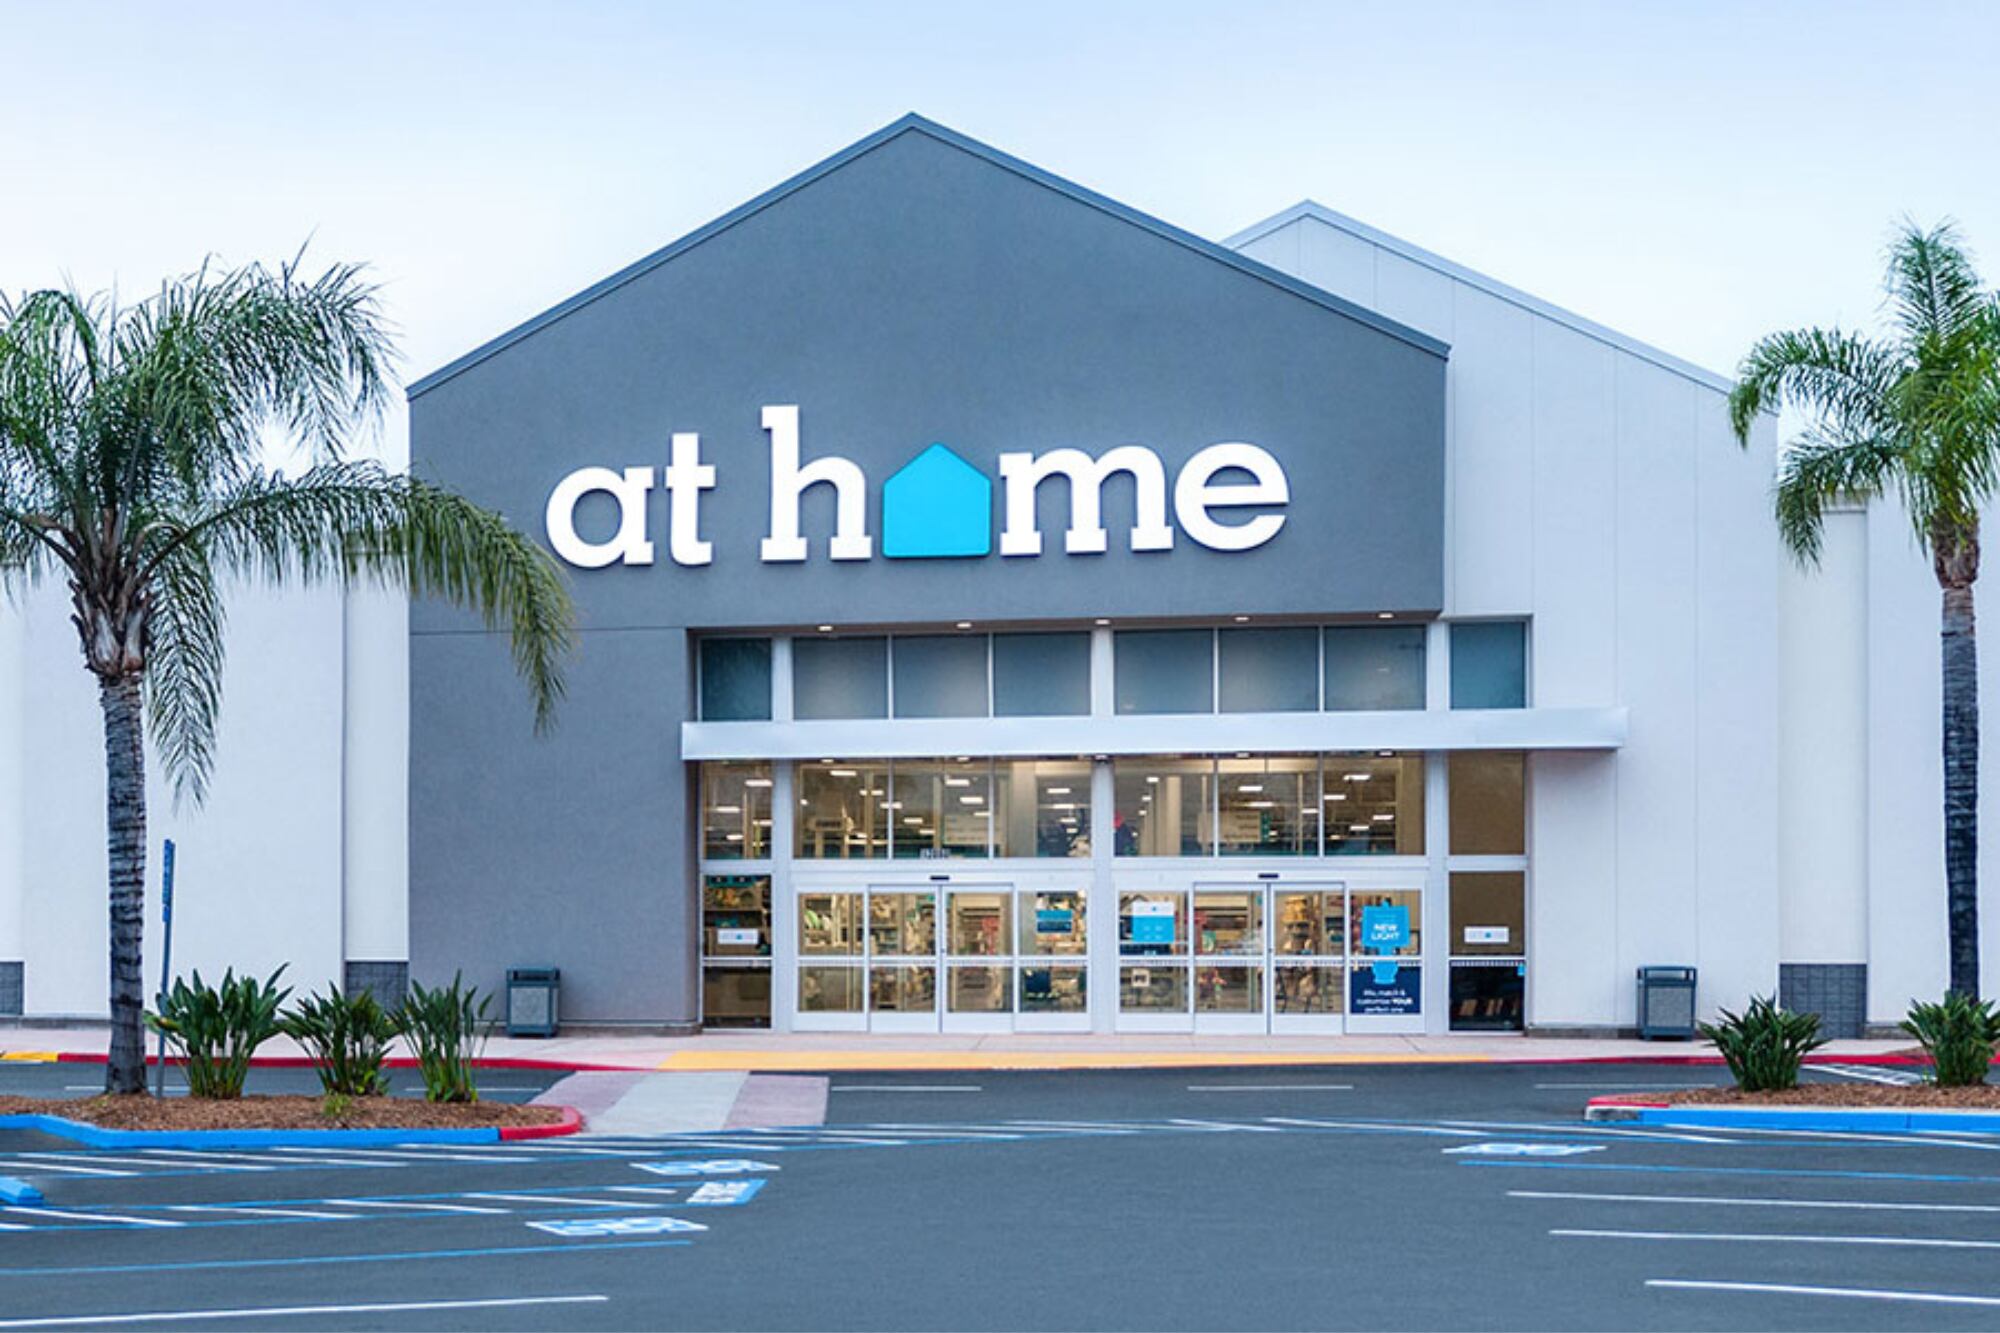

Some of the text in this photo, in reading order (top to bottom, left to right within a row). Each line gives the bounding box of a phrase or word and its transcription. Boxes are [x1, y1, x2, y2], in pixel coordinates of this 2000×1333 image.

[546, 405, 1289, 568] at hme
[1373, 923, 1398, 932] NEW
[1370, 931, 1400, 941] LIGHT
